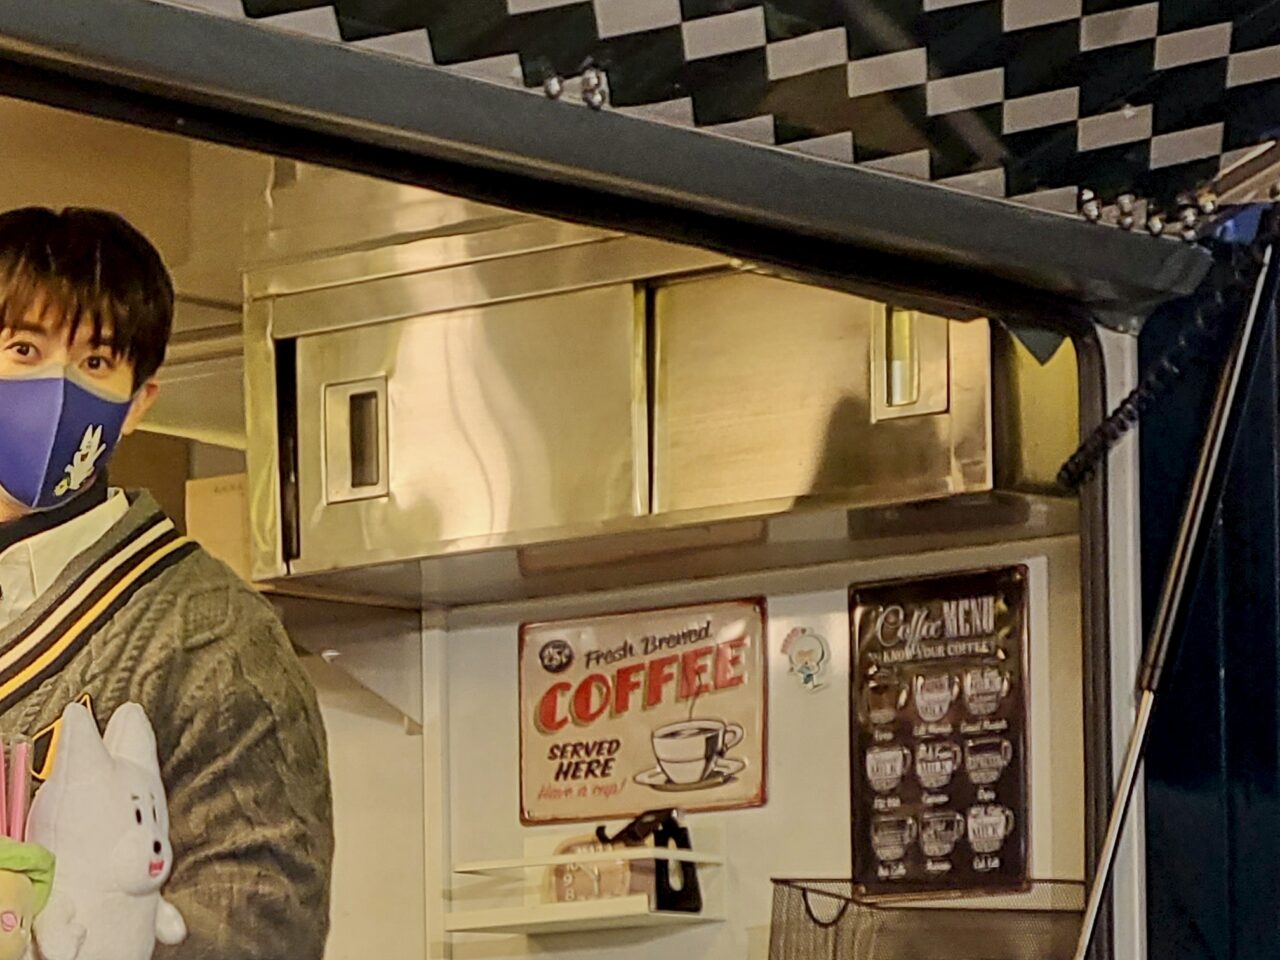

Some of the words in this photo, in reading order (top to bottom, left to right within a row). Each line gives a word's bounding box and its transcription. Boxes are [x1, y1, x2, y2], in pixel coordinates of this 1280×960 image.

[943, 596, 995, 638] MENU
[585, 640, 634, 669] Fresh
[641, 620, 713, 656] Brewed
[534, 635, 748, 735] COFFEE
[547, 739, 621, 761] SERVED
[554, 758, 616, 782] HERE
